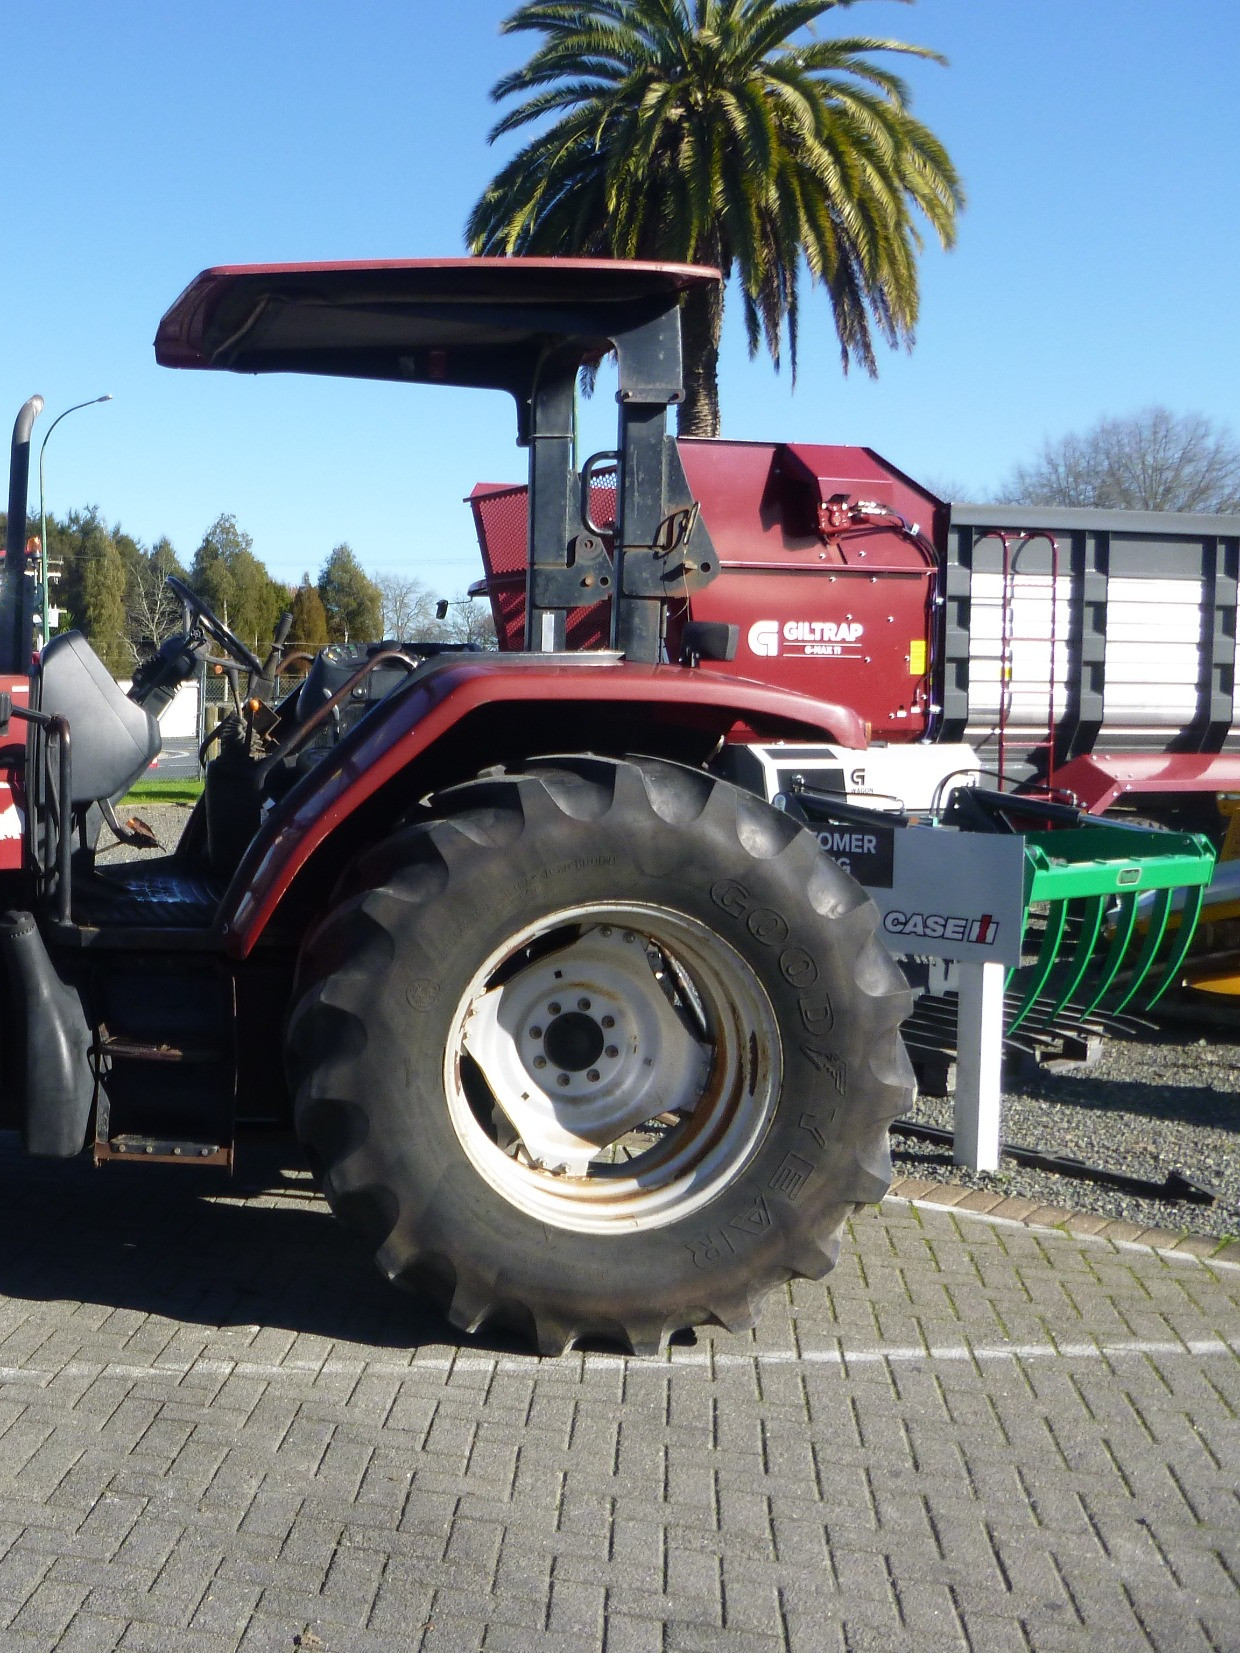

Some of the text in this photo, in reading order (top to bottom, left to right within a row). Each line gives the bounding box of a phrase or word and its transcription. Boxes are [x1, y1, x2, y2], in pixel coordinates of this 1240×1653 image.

[783, 621, 863, 642] GILTRAP
[883, 910, 968, 941] CASE
[686, 878, 845, 1270] GOODYEAR
